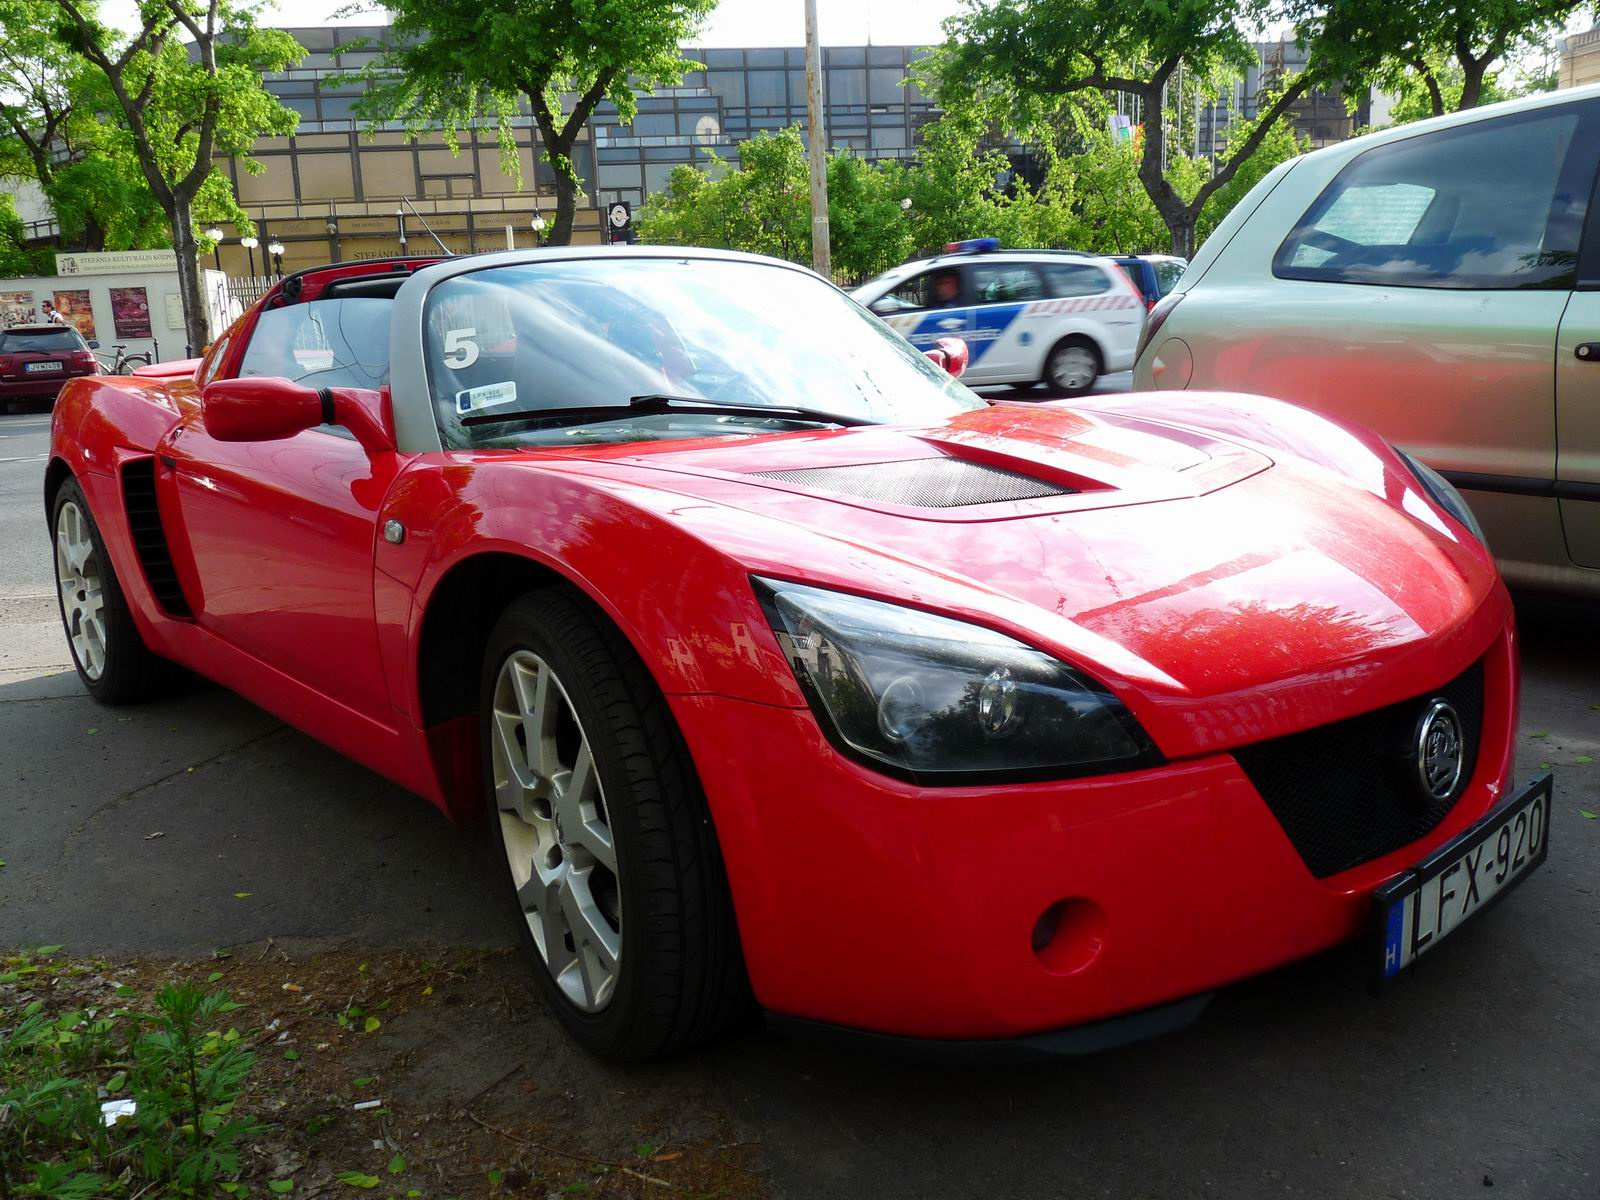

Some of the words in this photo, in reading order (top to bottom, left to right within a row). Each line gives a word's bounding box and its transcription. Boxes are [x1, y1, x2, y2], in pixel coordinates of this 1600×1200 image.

[80, 256, 111, 264] STEFÁNIA
[112, 255, 152, 263] KULTURÁLIS
[353, 250, 399, 260] STEFÁNIA
[443, 327, 480, 370] 5
[1410, 798, 1543, 958] LFX-920
